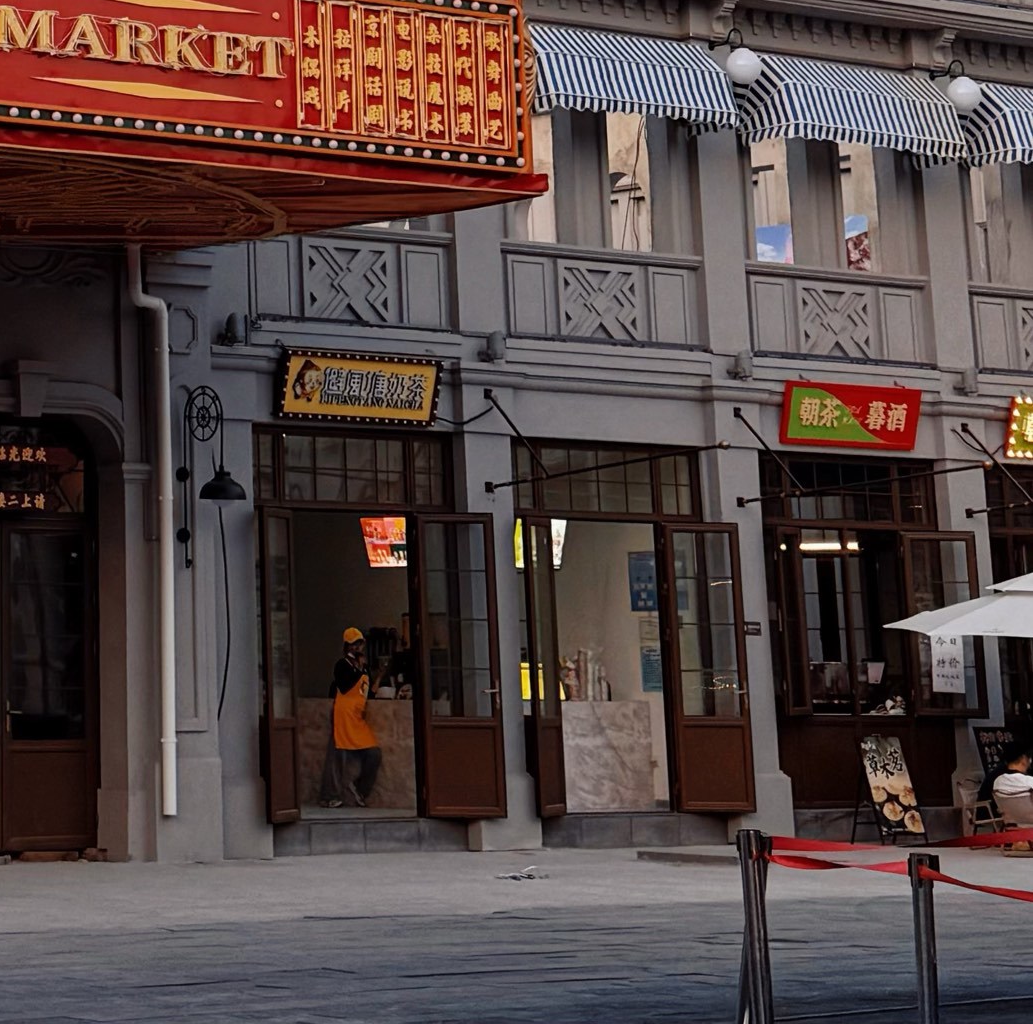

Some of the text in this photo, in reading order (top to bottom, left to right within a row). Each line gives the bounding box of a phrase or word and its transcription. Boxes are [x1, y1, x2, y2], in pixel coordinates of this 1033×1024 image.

[301, 25, 322, 110] 木偶戏
[364, 14, 384, 127] 京剧话剧
[395, 19, 415, 132] 电影说书
[425, 22, 445, 135] 杂技魔术
[484, 30, 503, 141] 歌舞曲艺
[800, 397, 841, 427] 朝茶
[864, 401, 908, 432] 暮酒
[935, 636, 957, 647] 今日
